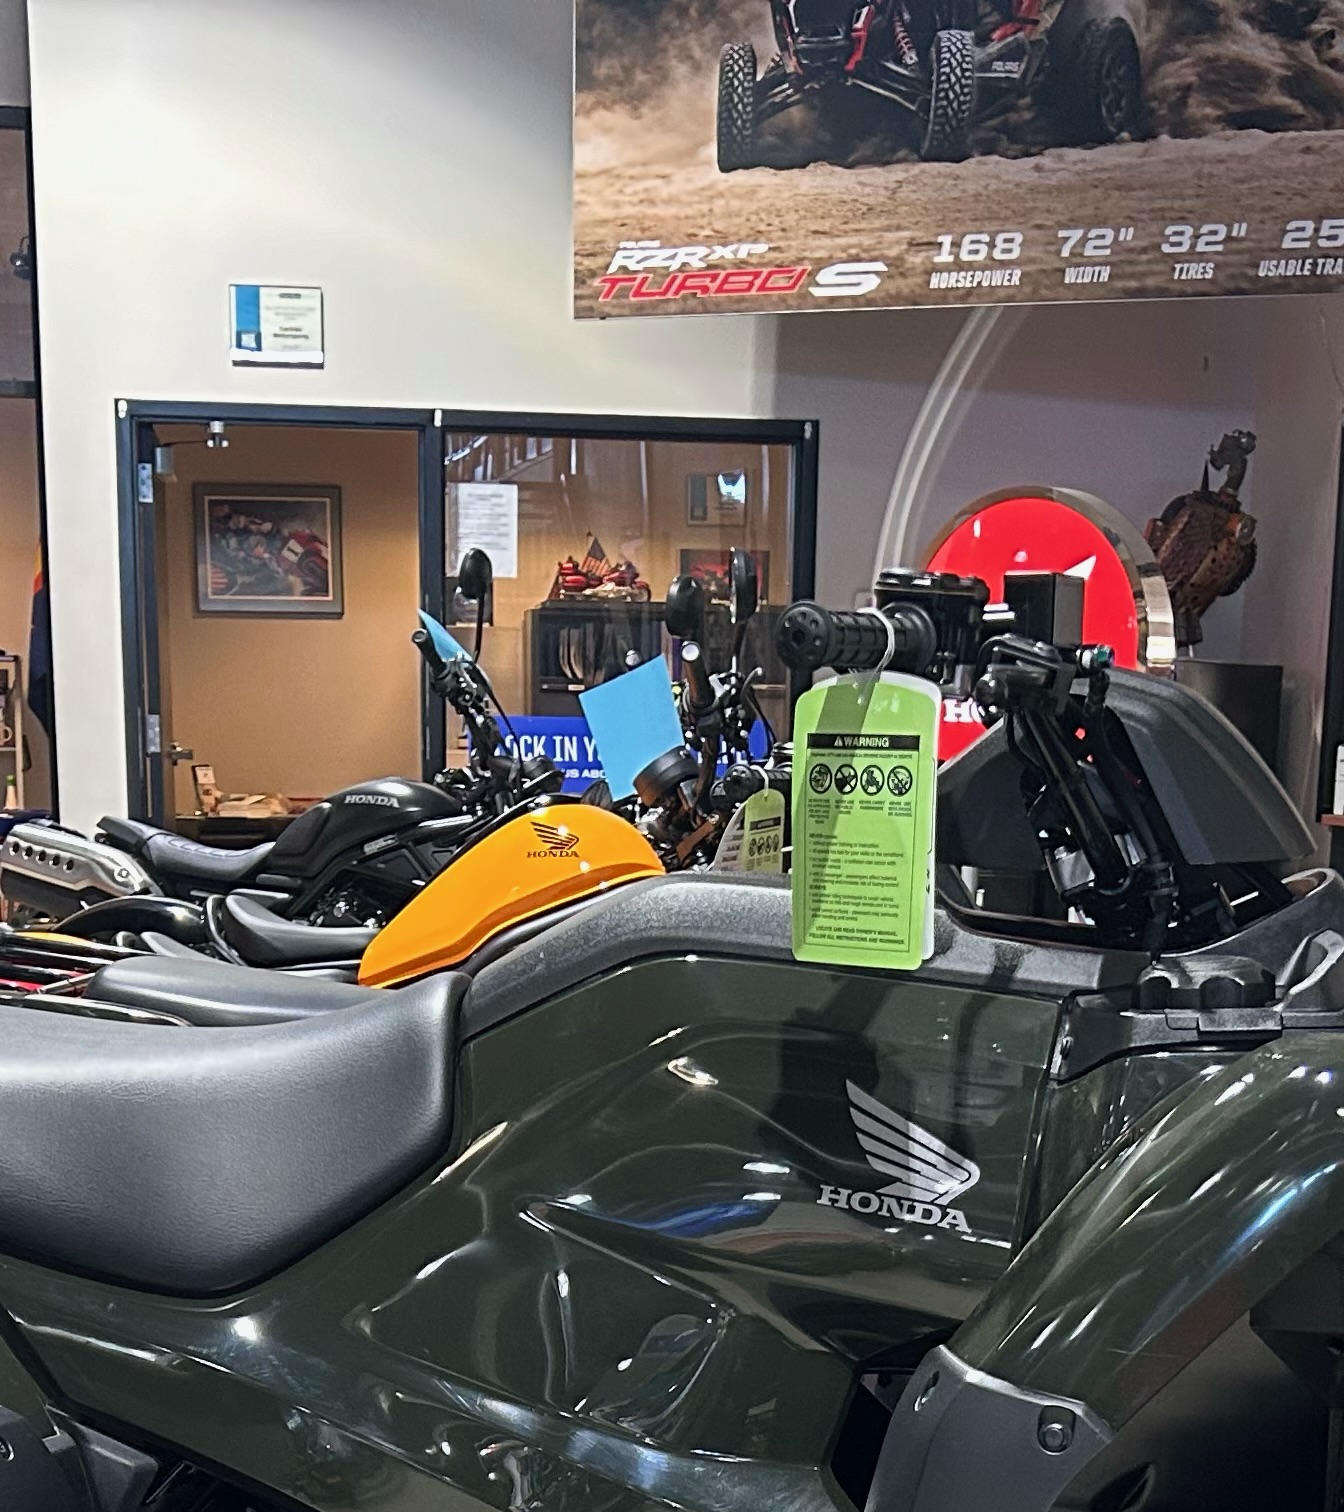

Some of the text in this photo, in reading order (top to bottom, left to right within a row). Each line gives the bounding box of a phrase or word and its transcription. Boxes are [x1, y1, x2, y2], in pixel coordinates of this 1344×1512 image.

[933, 231, 1022, 263] 168
[1057, 227, 1134, 258] 72"
[1161, 222, 1247, 254] 32"
[1064, 265, 1111, 284] WIDTH
[1173, 262, 1214, 281] TIRES
[1258, 258, 1312, 278] USABLE
[595, 261, 888, 302] TURBO S
[929, 269, 1021, 289] HORSEPOWER
[552, 734, 579, 762] IN
[843, 735, 890, 749] WARNING
[344, 794, 400, 809] HONDA
[526, 849, 580, 858] HONDA
[816, 1184, 973, 1234] HONDA
